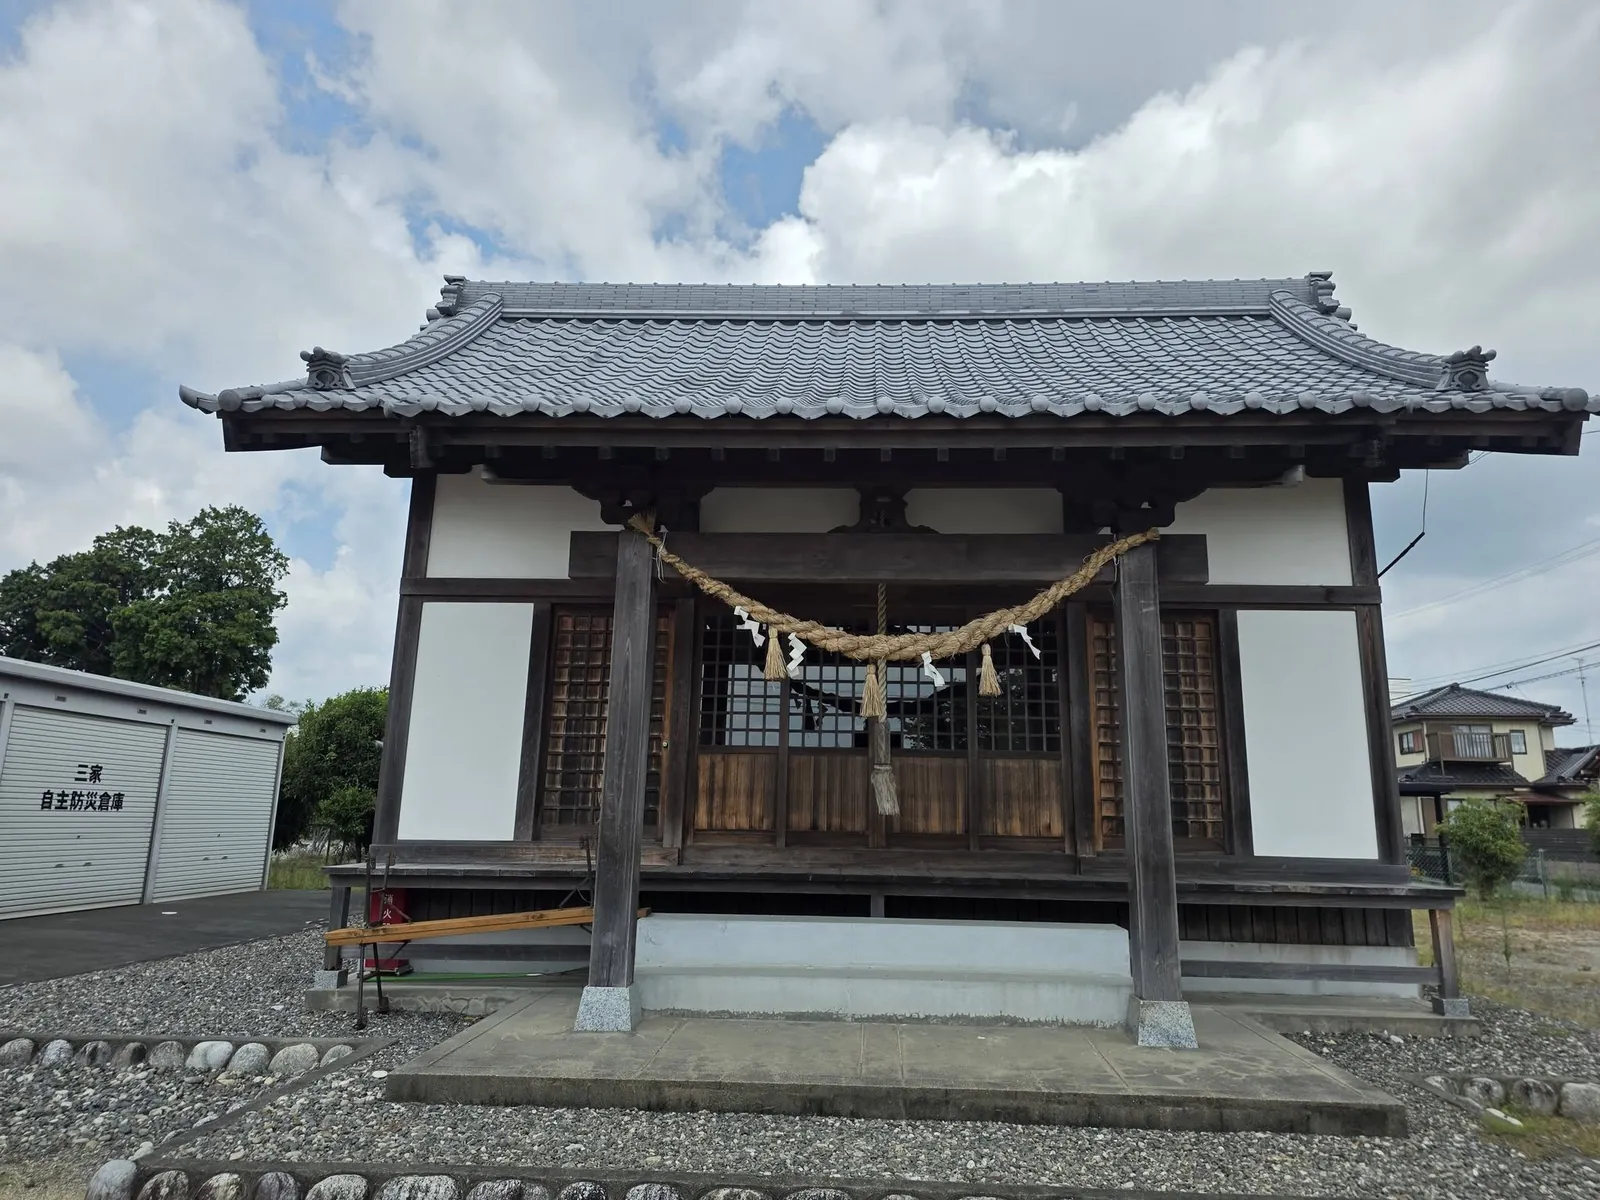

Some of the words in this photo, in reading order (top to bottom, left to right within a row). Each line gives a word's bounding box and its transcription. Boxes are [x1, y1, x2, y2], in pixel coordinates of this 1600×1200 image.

[74, 764, 103, 784] 三家
[40, 790, 125, 811] 自主防災倉庫
[383, 894, 394, 926] 消火
